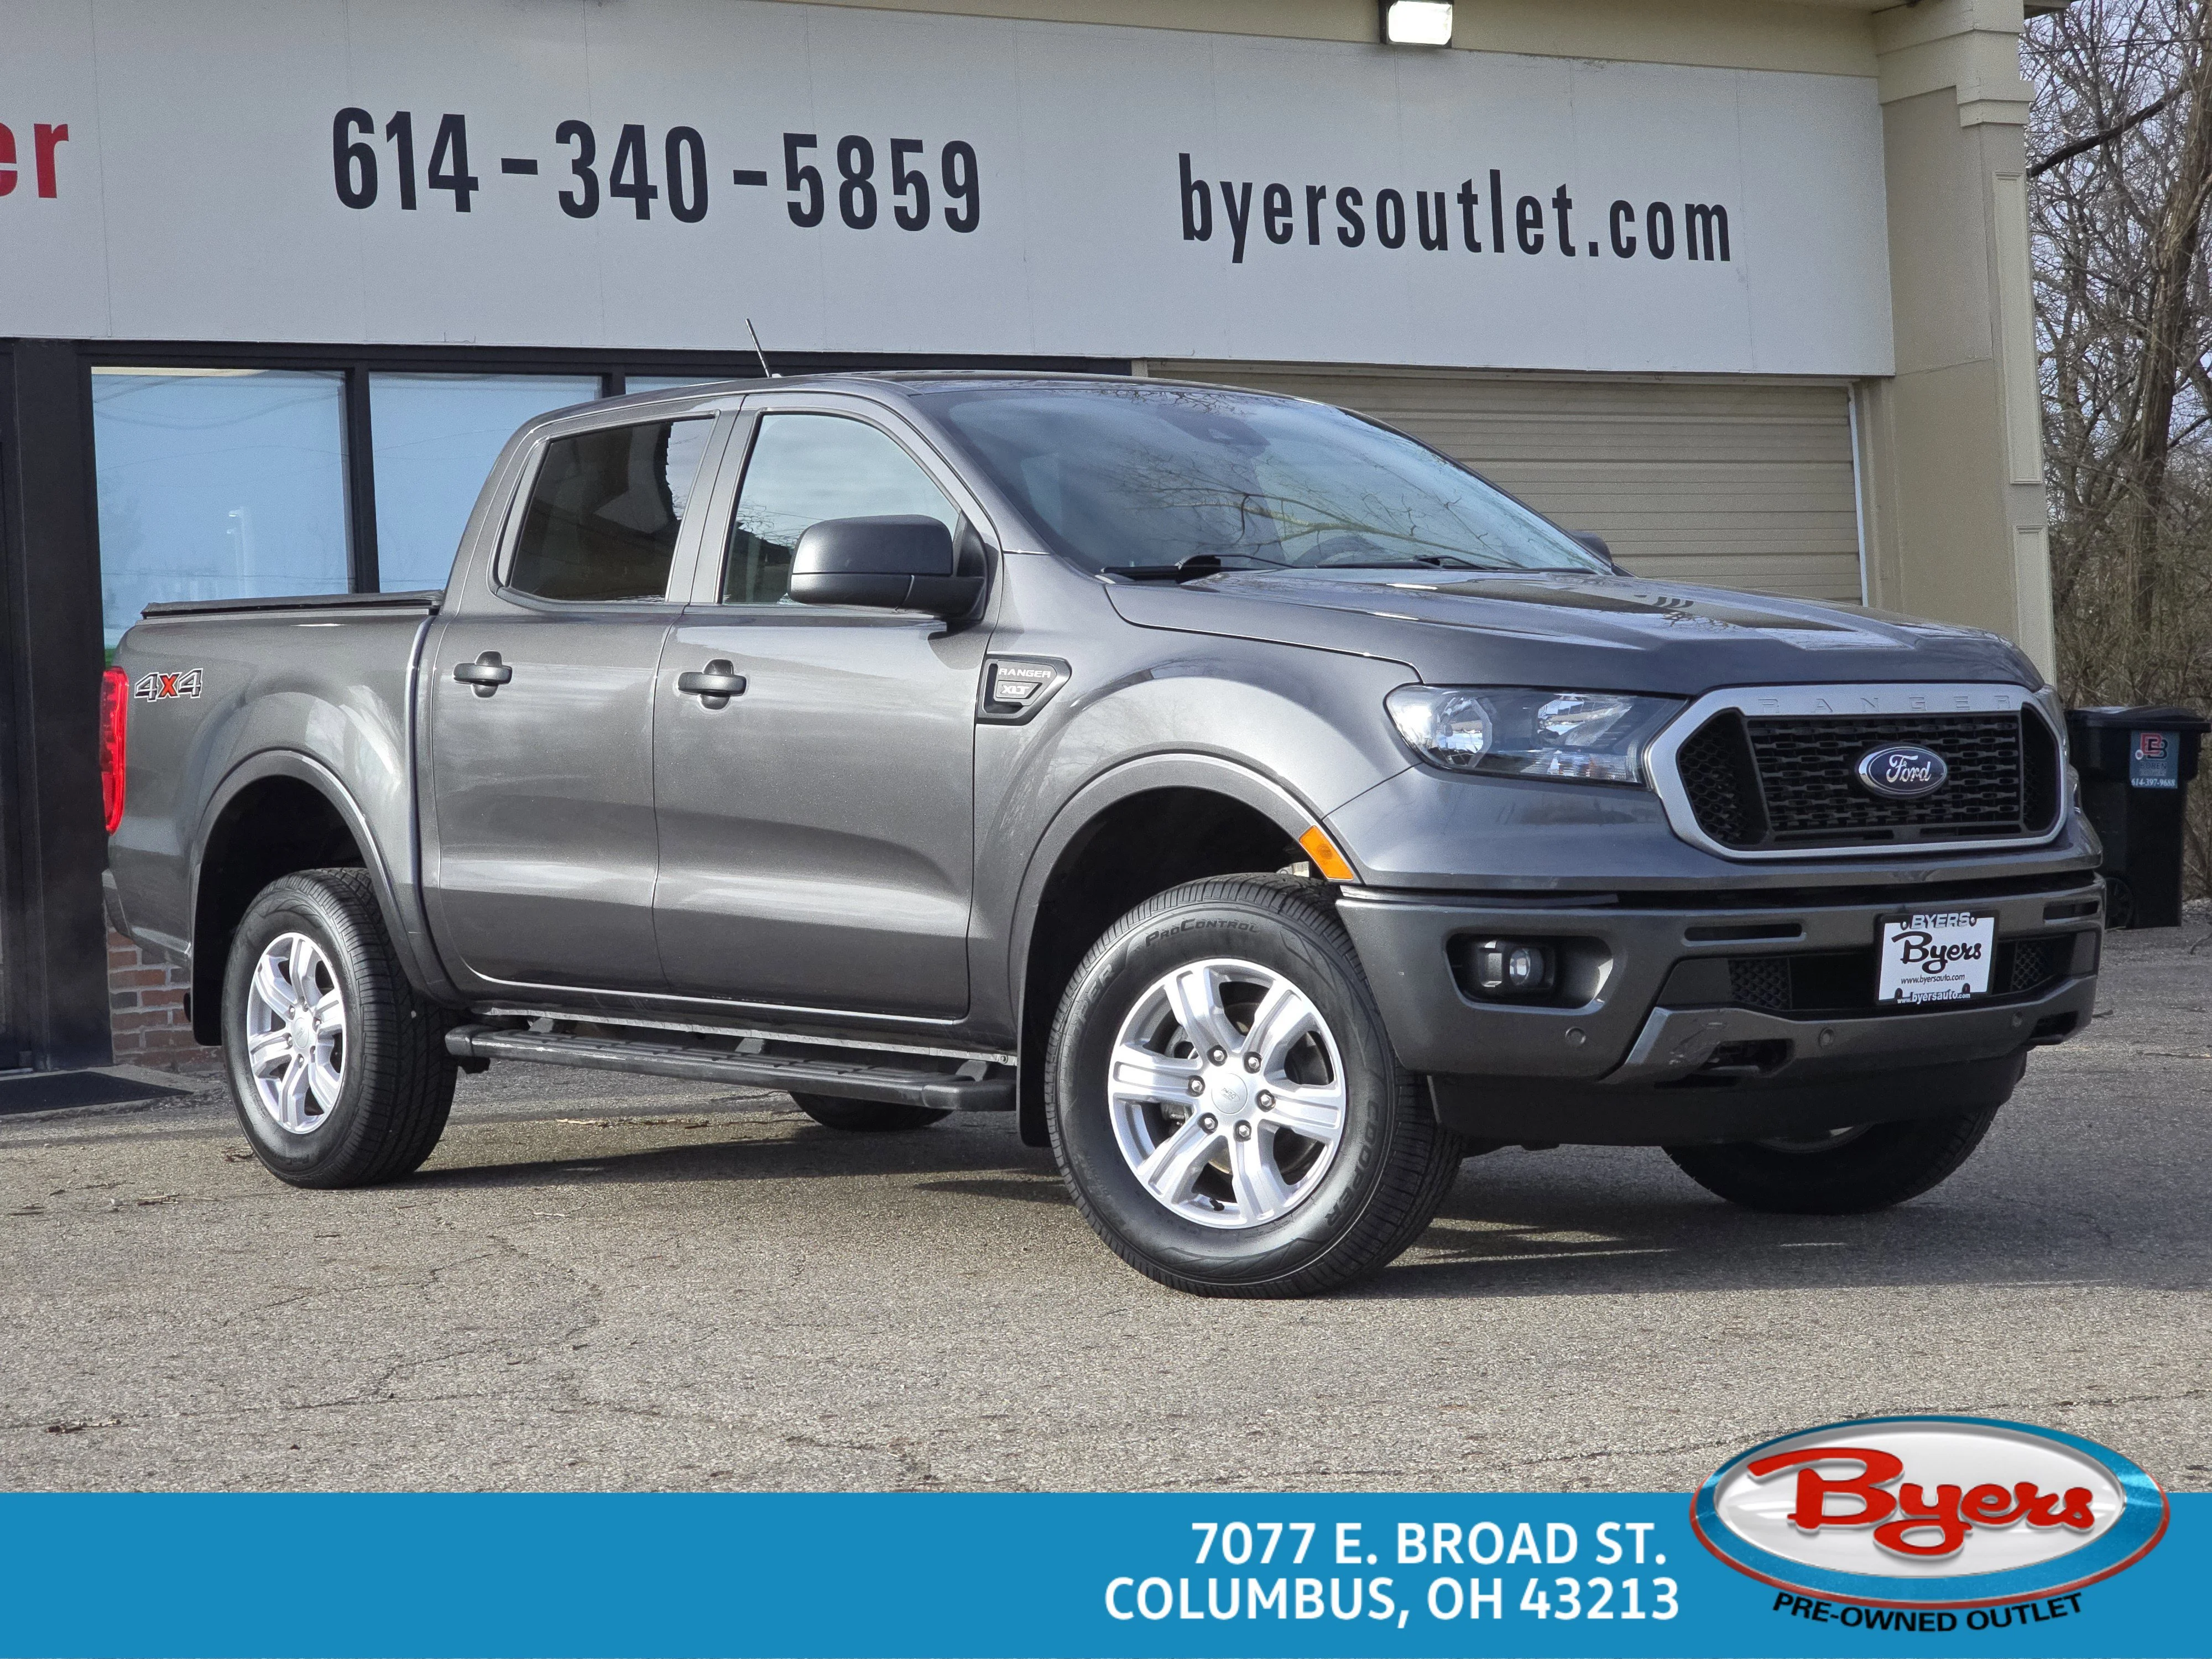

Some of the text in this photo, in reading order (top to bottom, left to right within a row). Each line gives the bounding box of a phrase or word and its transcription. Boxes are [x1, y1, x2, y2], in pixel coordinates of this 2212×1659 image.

[1178, 153, 1730, 264] byersoutlet.com
[999, 668, 1051, 679] RANGER
[1001, 685, 1029, 695] XLT
[1757, 695, 2014, 713] RANGER
[1886, 753, 1933, 783] Ford
[1911, 912, 1971, 930] BYERS
[1891, 931, 1982, 974] Byers
[1901, 973, 1965, 985] www.byersauto.com
[1897, 989, 1971, 1005] www.byersauto.com
